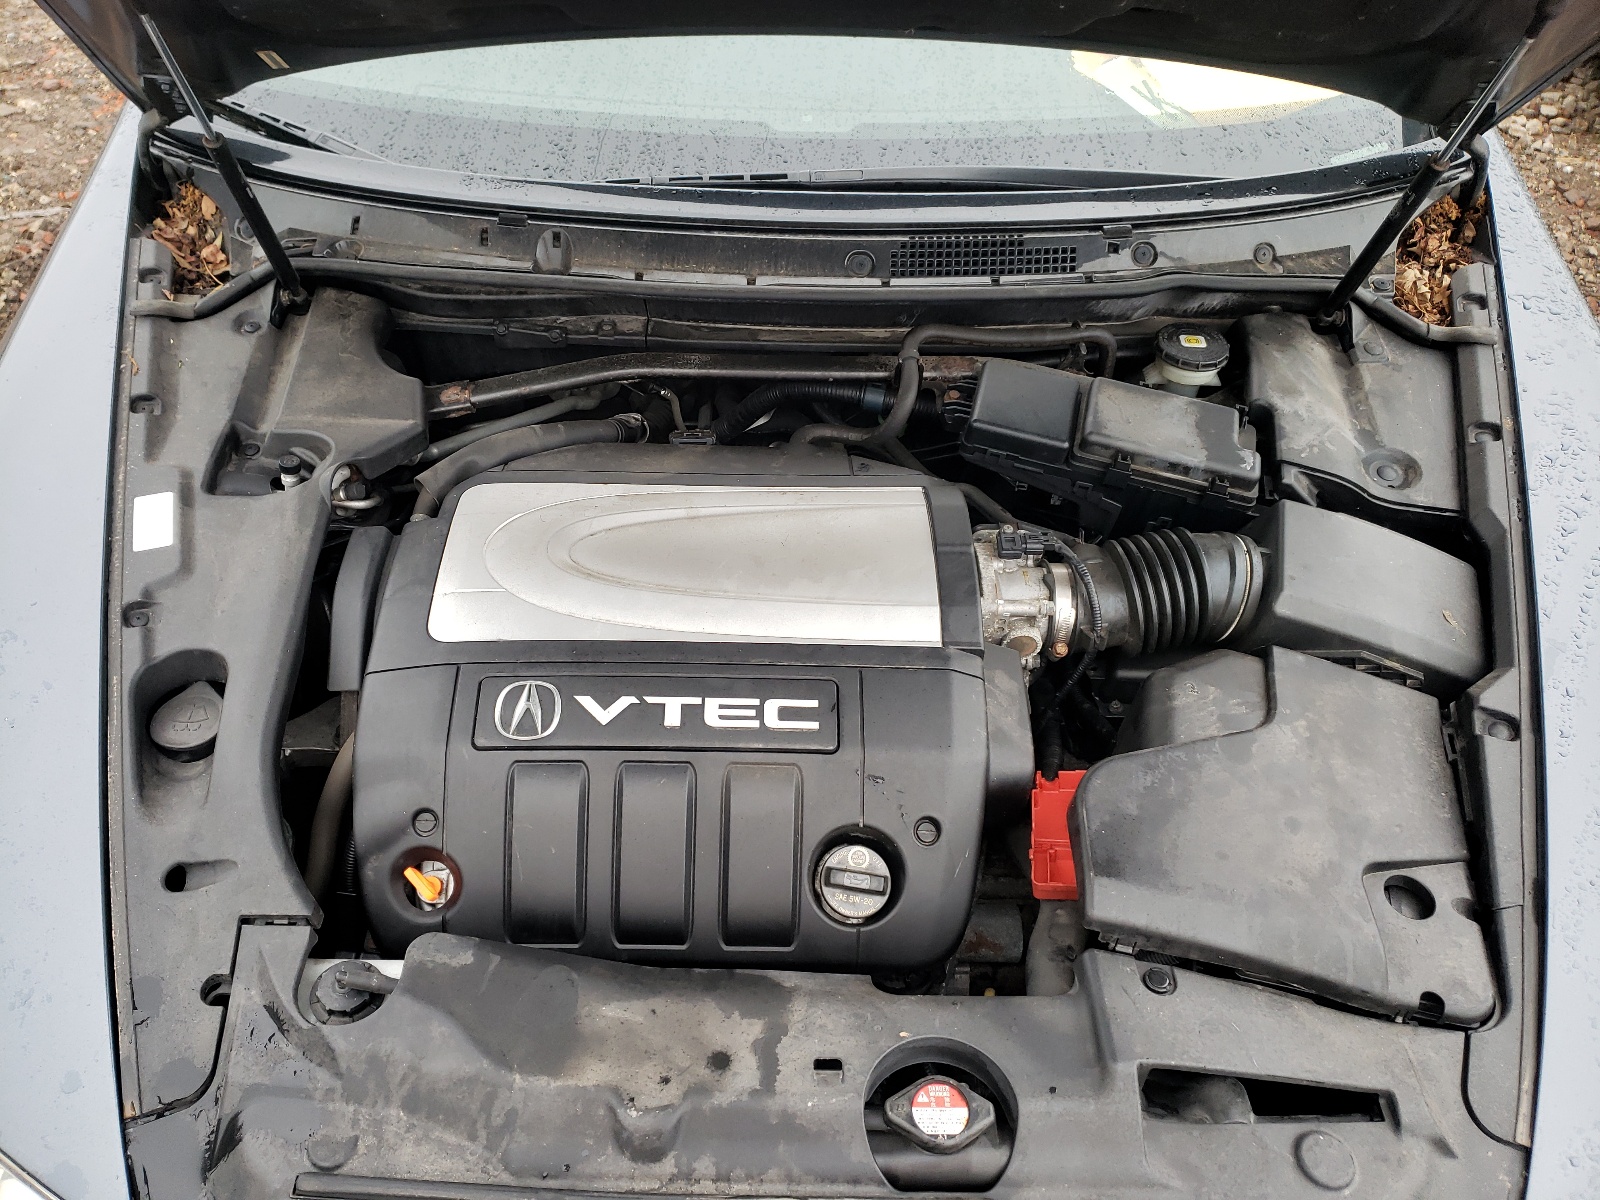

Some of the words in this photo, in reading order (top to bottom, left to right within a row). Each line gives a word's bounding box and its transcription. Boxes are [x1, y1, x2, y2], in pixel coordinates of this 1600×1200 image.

[573, 695, 820, 730] VTEC
[834, 892, 848, 902] SAE
[848, 895, 873, 905] 5W-20
